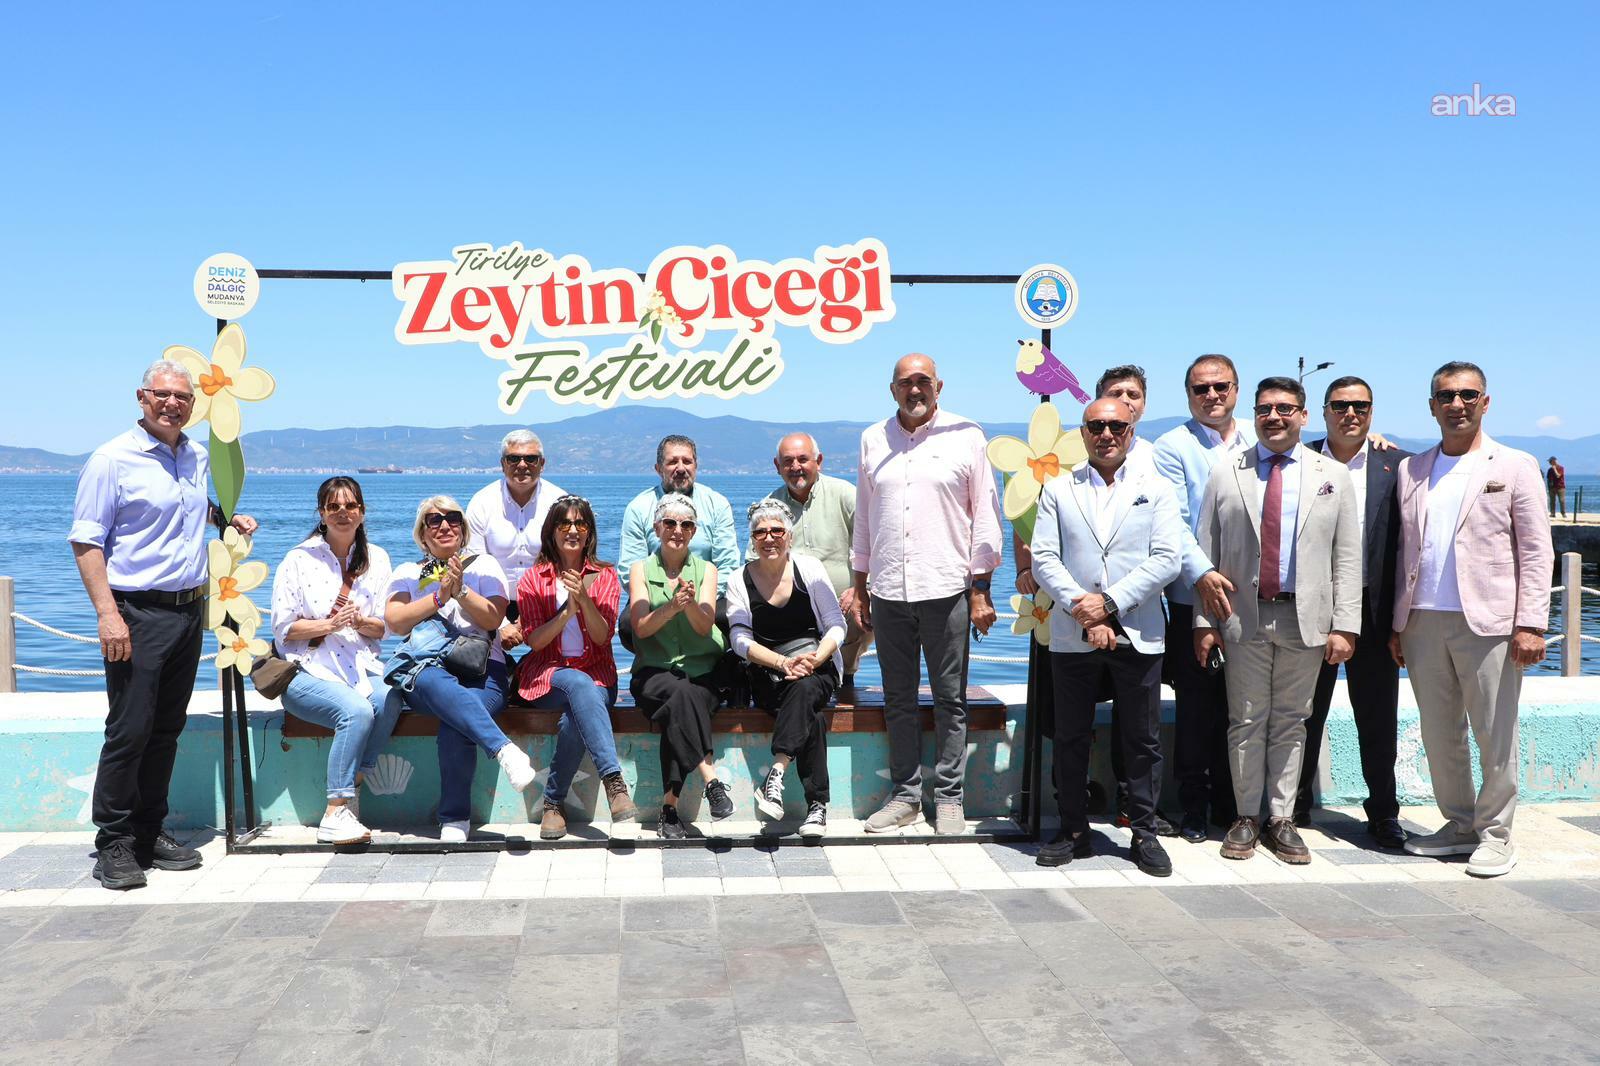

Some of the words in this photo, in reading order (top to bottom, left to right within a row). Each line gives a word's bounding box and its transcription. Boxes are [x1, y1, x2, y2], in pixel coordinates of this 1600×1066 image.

[455, 246, 549, 281] Tirilye
[207, 283, 246, 294] DALGIÇ
[207, 293, 245, 301] MUDANYA
[402, 265, 638, 349] Zeytin
[655, 248, 885, 337] Çiçeği
[505, 338, 776, 406] Festivali
